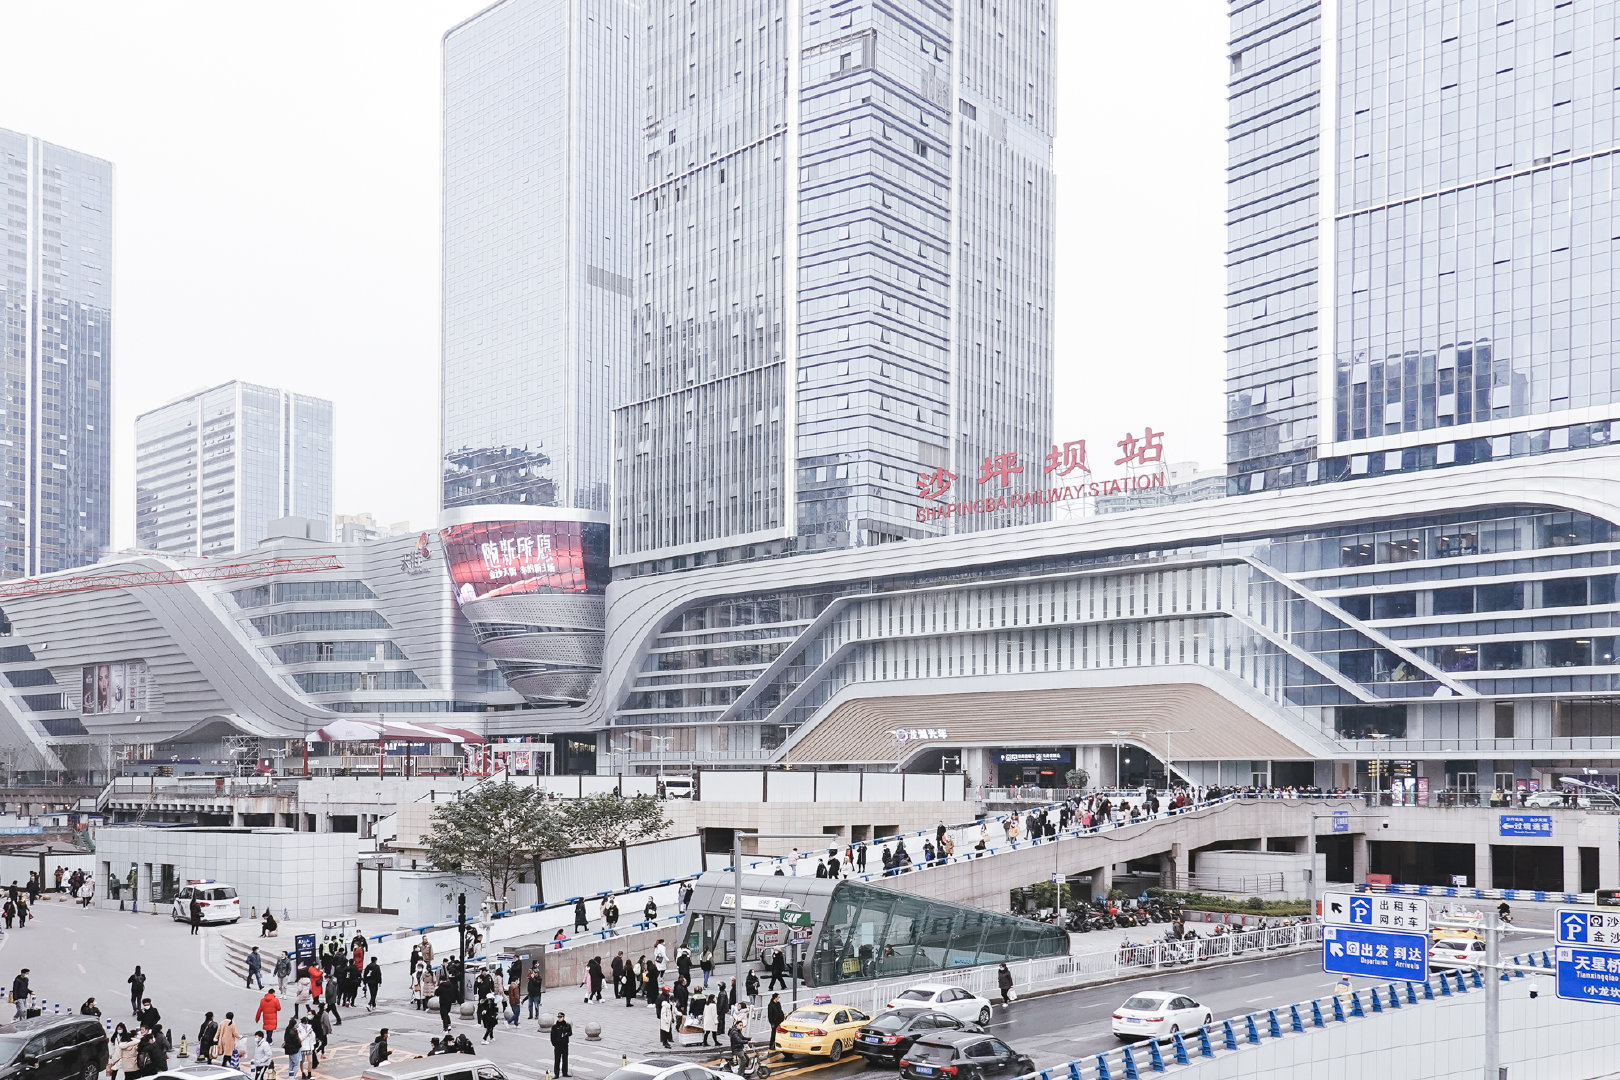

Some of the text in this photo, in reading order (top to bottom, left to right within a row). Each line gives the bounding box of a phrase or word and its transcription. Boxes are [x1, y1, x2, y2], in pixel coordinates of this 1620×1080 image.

[916, 427, 1165, 499] 沙坪坝站
[916, 472, 1165, 522] SHAPINGBA RAILWAY STATION
[1380, 900, 1418, 913] 出租车
[1354, 907, 1368, 923] P
[1380, 914, 1418, 927] 网约车
[1607, 916, 1620, 928] 沙
[1566, 923, 1582, 940] P
[1593, 930, 1620, 944] 金沙
[1361, 943, 1423, 962] 出发 到达
[1360, 956, 1420, 970] Departures Arrivals
[1574, 956, 1620, 974] 天星桥
[1576, 970, 1619, 982] Tianxingqiao
